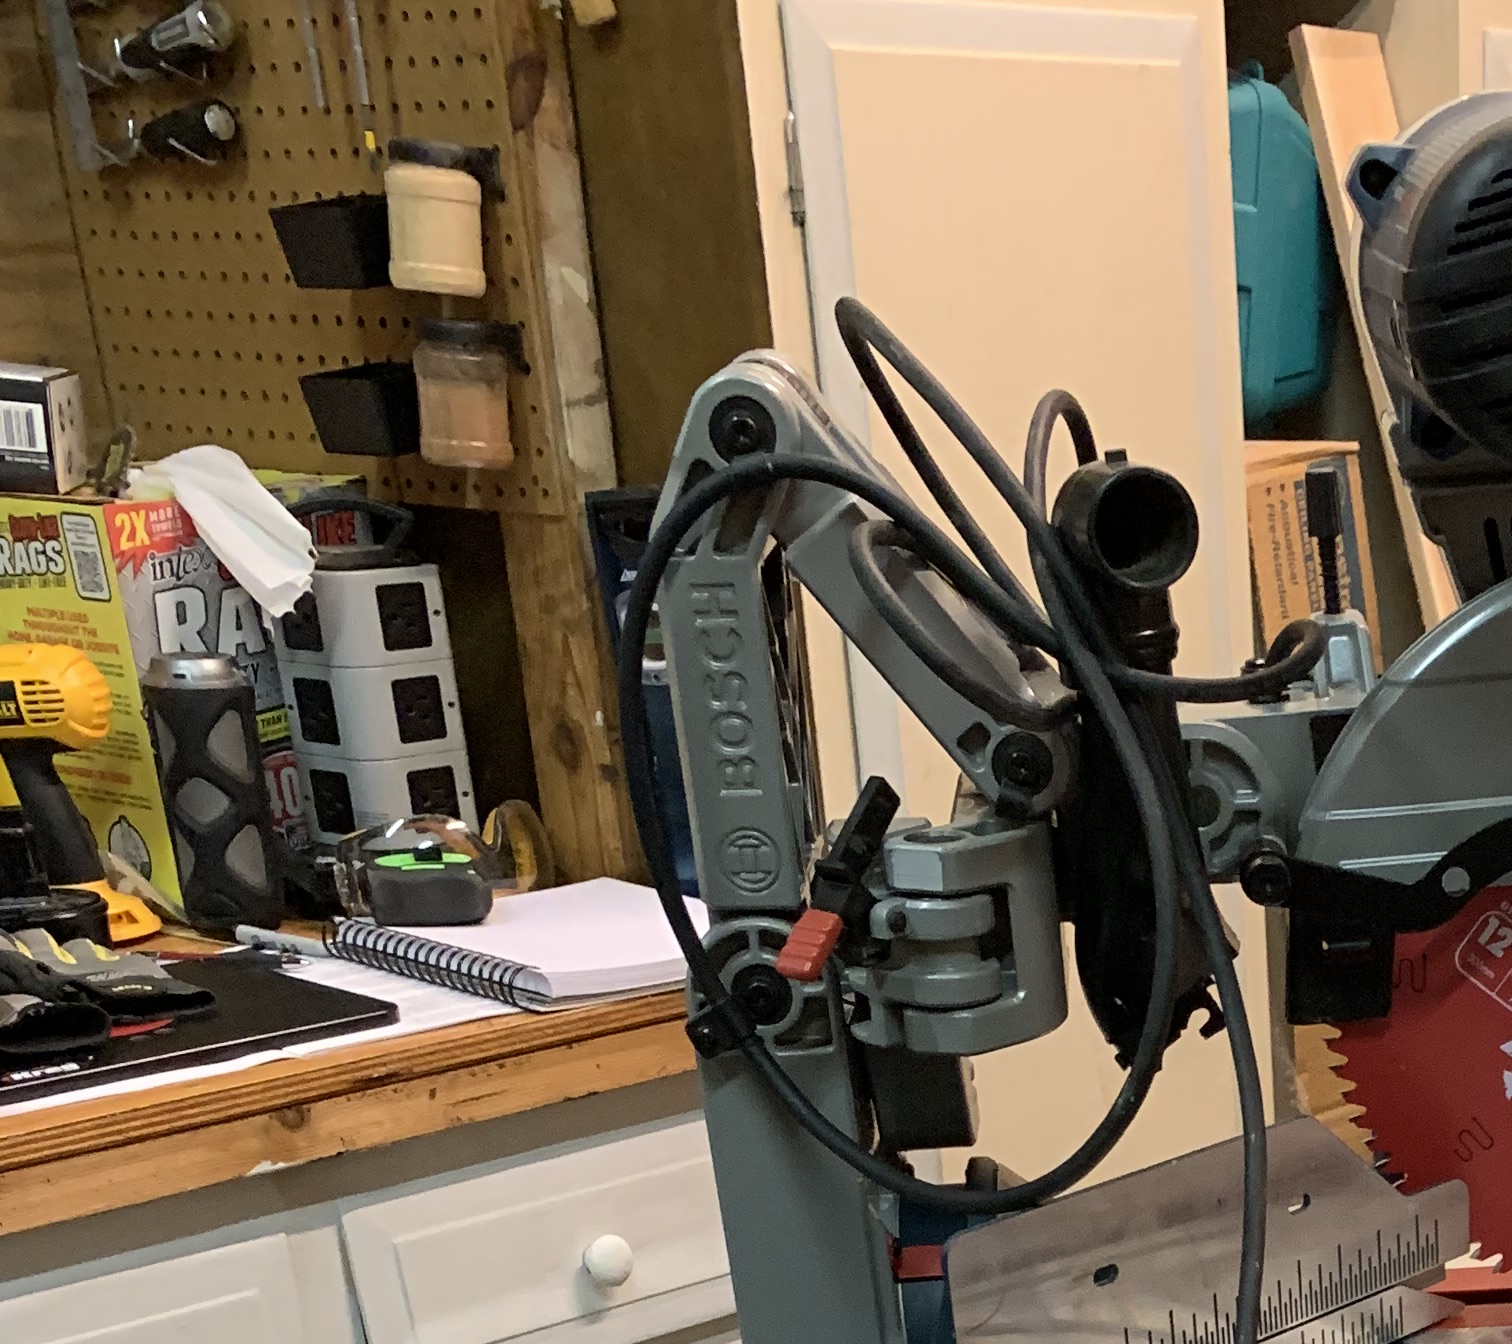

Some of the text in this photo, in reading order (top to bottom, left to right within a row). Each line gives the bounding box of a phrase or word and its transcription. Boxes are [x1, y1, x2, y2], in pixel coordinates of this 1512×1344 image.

[114, 509, 150, 551] 2X
[154, 586, 268, 657] RA
[689, 582, 764, 797] BOSCH
